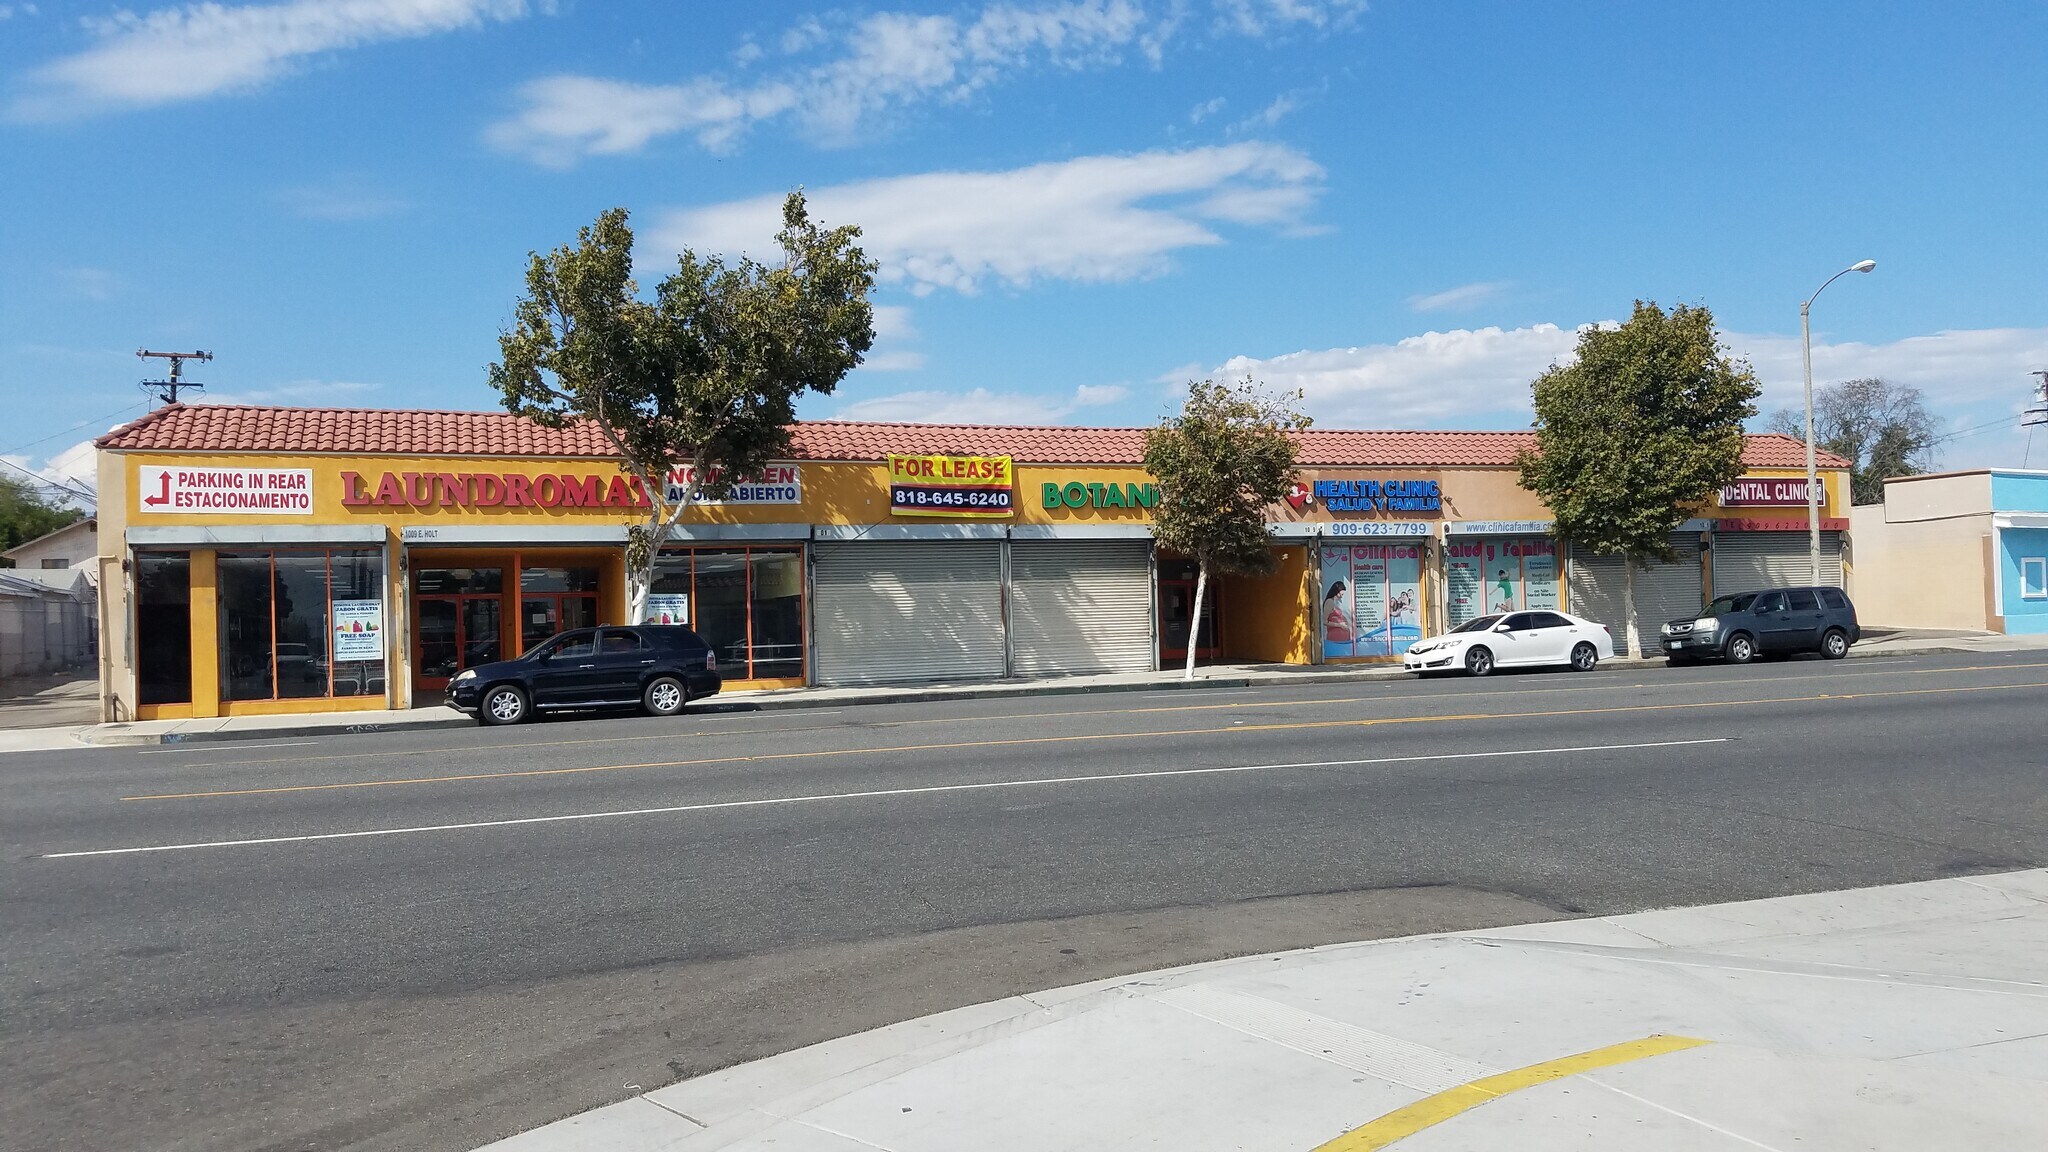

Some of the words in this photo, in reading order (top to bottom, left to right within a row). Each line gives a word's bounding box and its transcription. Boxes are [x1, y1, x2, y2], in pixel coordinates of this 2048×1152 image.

[894, 459, 934, 477] FOR
[942, 461, 1004, 479] LEASE
[178, 472, 243, 489] PARKING
[249, 473, 263, 489] IN
[268, 474, 306, 490] REAR
[340, 471, 658, 508] LAUNDROMAT
[1314, 479, 1380, 497] HEALTH
[1383, 479, 1440, 497] CLINIC
[175, 491, 309, 509] ESTACIONAMENTO
[730, 487, 796, 501] ABIERTO
[895, 490, 1008, 506] 818-645-6240
[1725, 484, 1771, 501] DENTAL
[1326, 497, 1373, 511] SALUD
[1375, 498, 1385, 511] Y
[1387, 497, 1441, 511] FAMILIA
[425, 529, 438, 538] HOLT
[1332, 523, 1426, 535] 909-623-7799
[1354, 545, 1418, 559] Clinica
[1487, 545, 1495, 562] y
